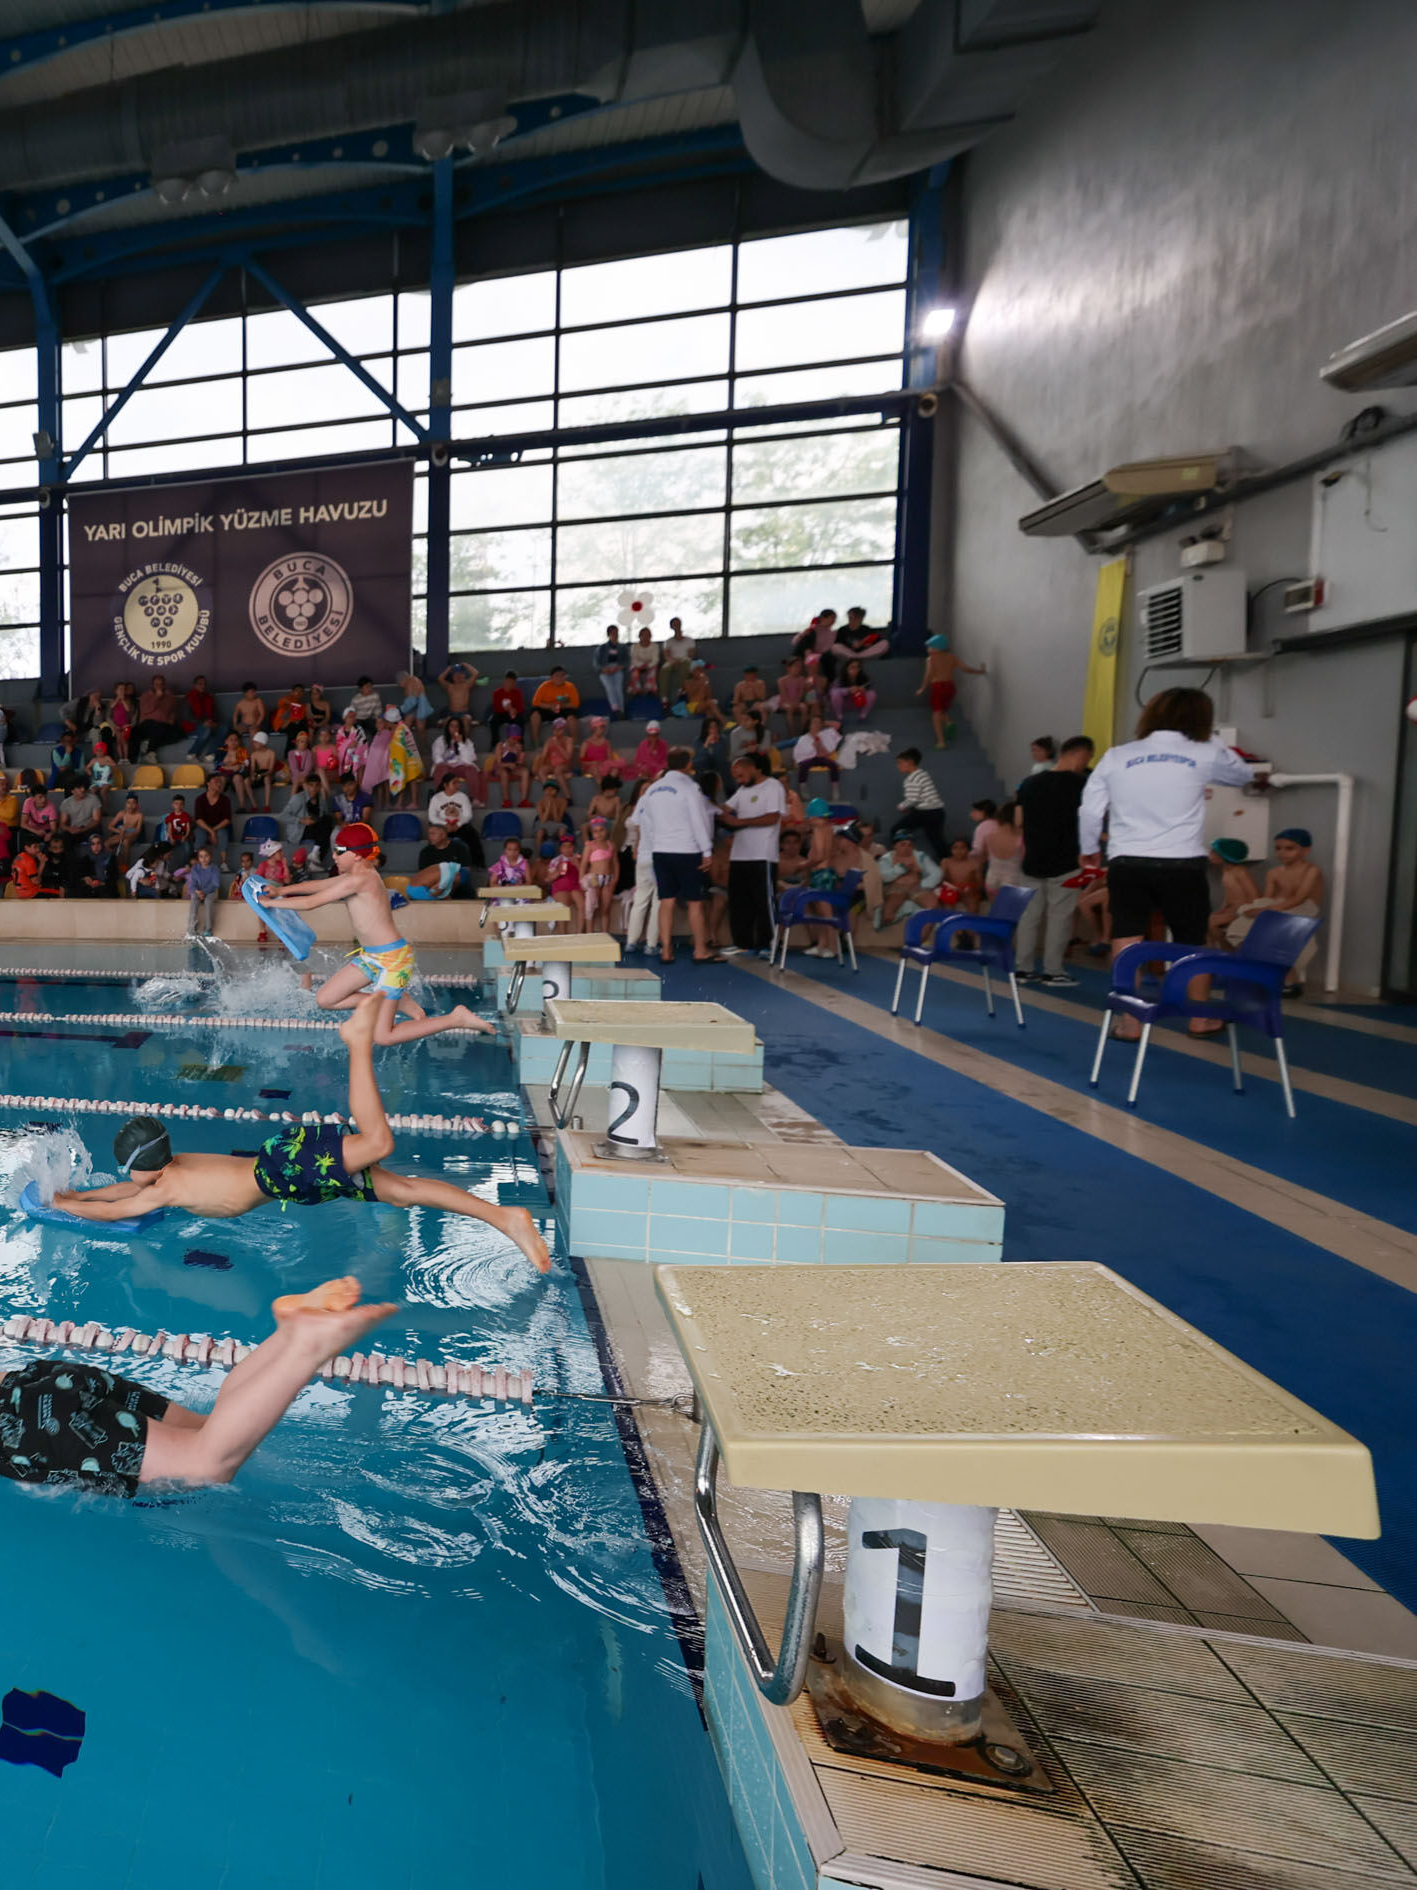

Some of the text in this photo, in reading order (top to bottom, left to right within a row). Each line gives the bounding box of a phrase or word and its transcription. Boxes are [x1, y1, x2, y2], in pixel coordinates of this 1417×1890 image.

[84, 499, 388, 541] YARI OLİMPİK YÜZME HAVUZU
[118, 562, 204, 593] BUCA BELEDİYESİ
[273, 560, 326, 580] BUCA
[141, 653, 155, 666] VE
[157, 649, 186, 666] SPOR
[151, 640, 172, 649] 1990
[607, 1081, 640, 1146] 2
[854, 1528, 957, 1698] 1
